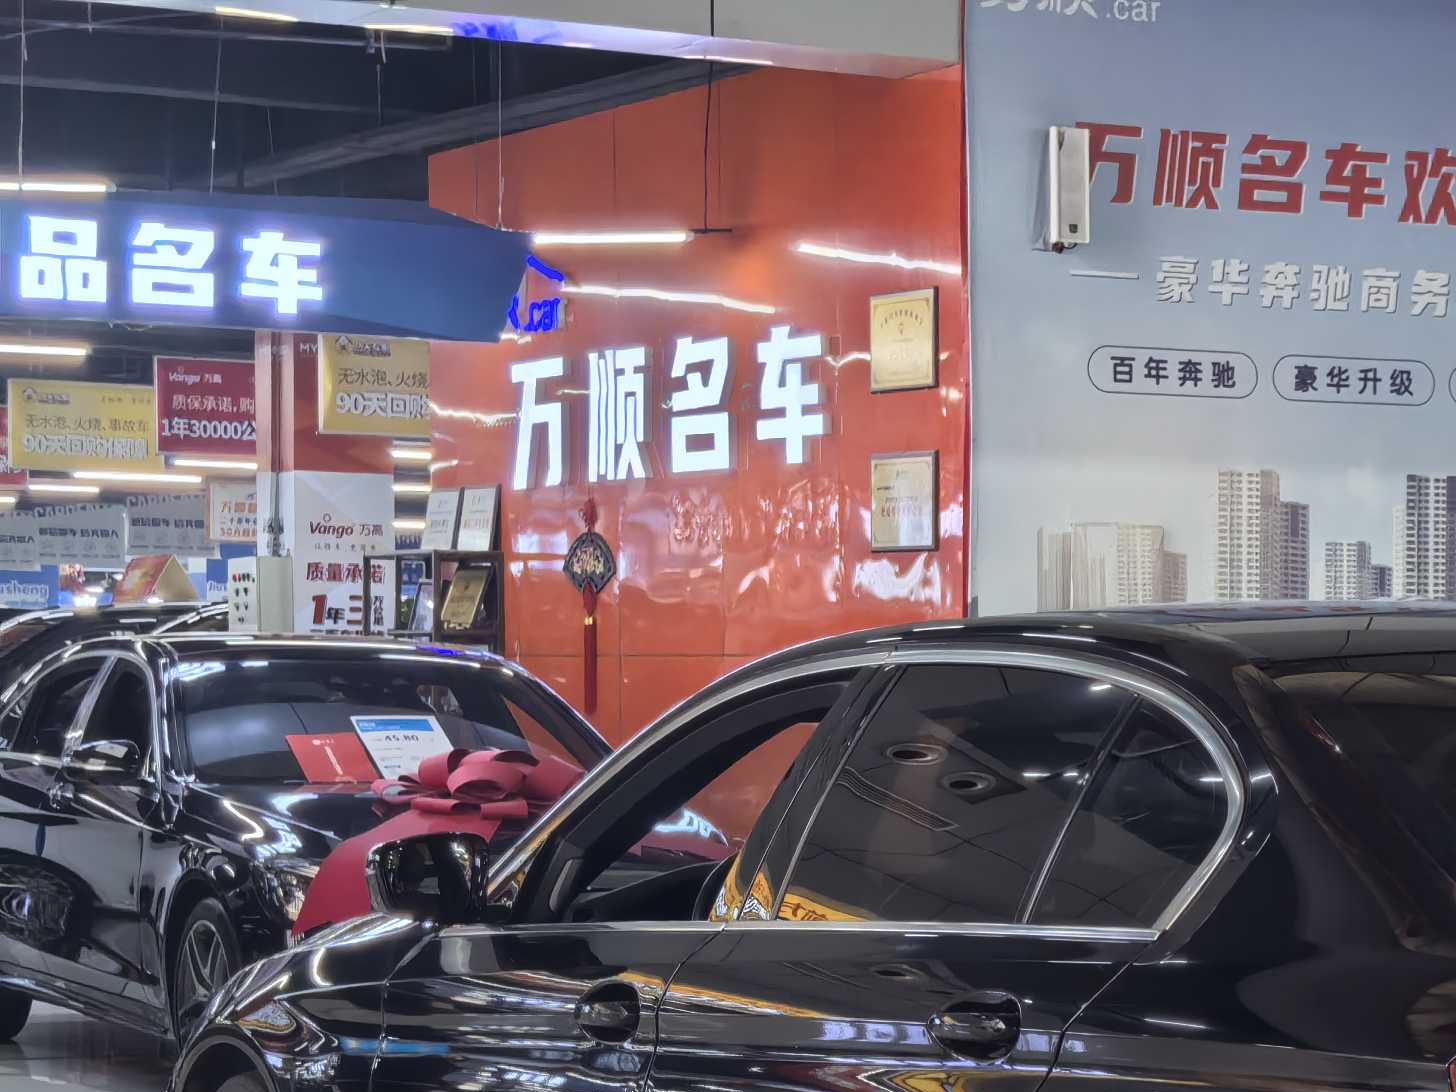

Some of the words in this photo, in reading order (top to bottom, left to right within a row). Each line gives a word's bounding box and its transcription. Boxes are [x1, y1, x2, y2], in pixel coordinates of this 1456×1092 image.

[20, 215, 323, 315] 品名车
[1110, 354, 1238, 391] 百年奔驰
[1293, 364, 1416, 398] 豪华升级
[510, 325, 825, 491] 万顺名车
[310, 521, 353, 538] Vango
